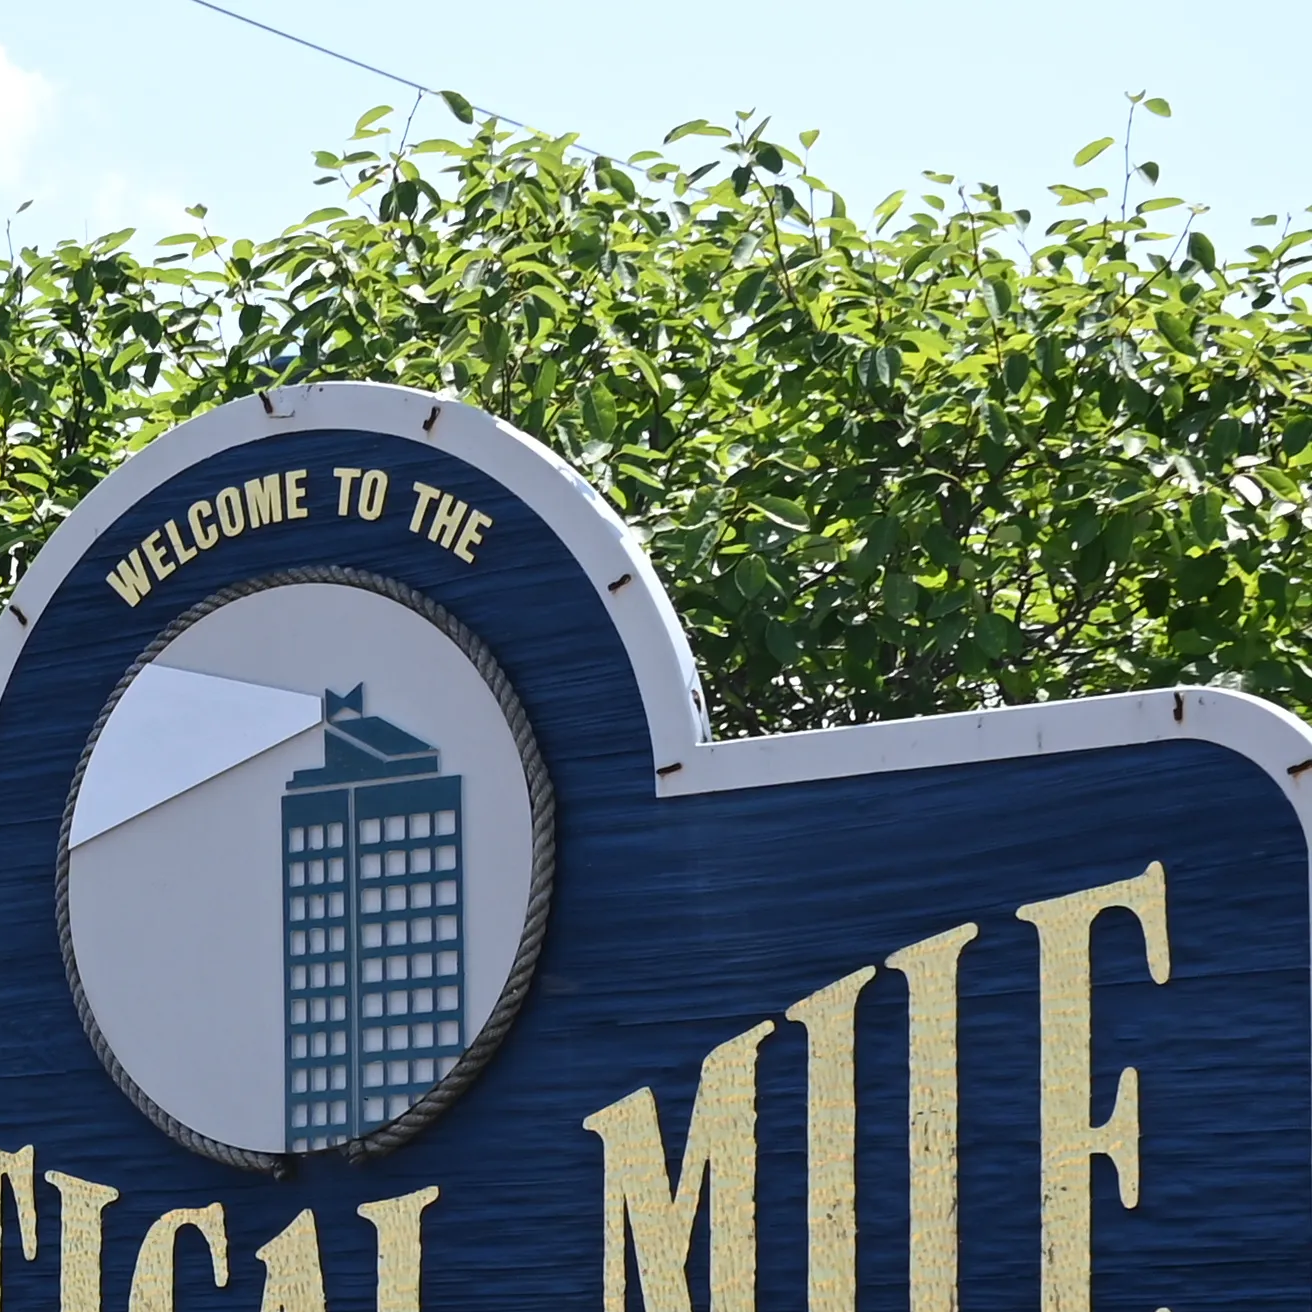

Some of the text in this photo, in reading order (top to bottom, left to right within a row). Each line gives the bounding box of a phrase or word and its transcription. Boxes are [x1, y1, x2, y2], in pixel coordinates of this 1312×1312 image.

[105, 467, 493, 608] WELCOME TO THE
